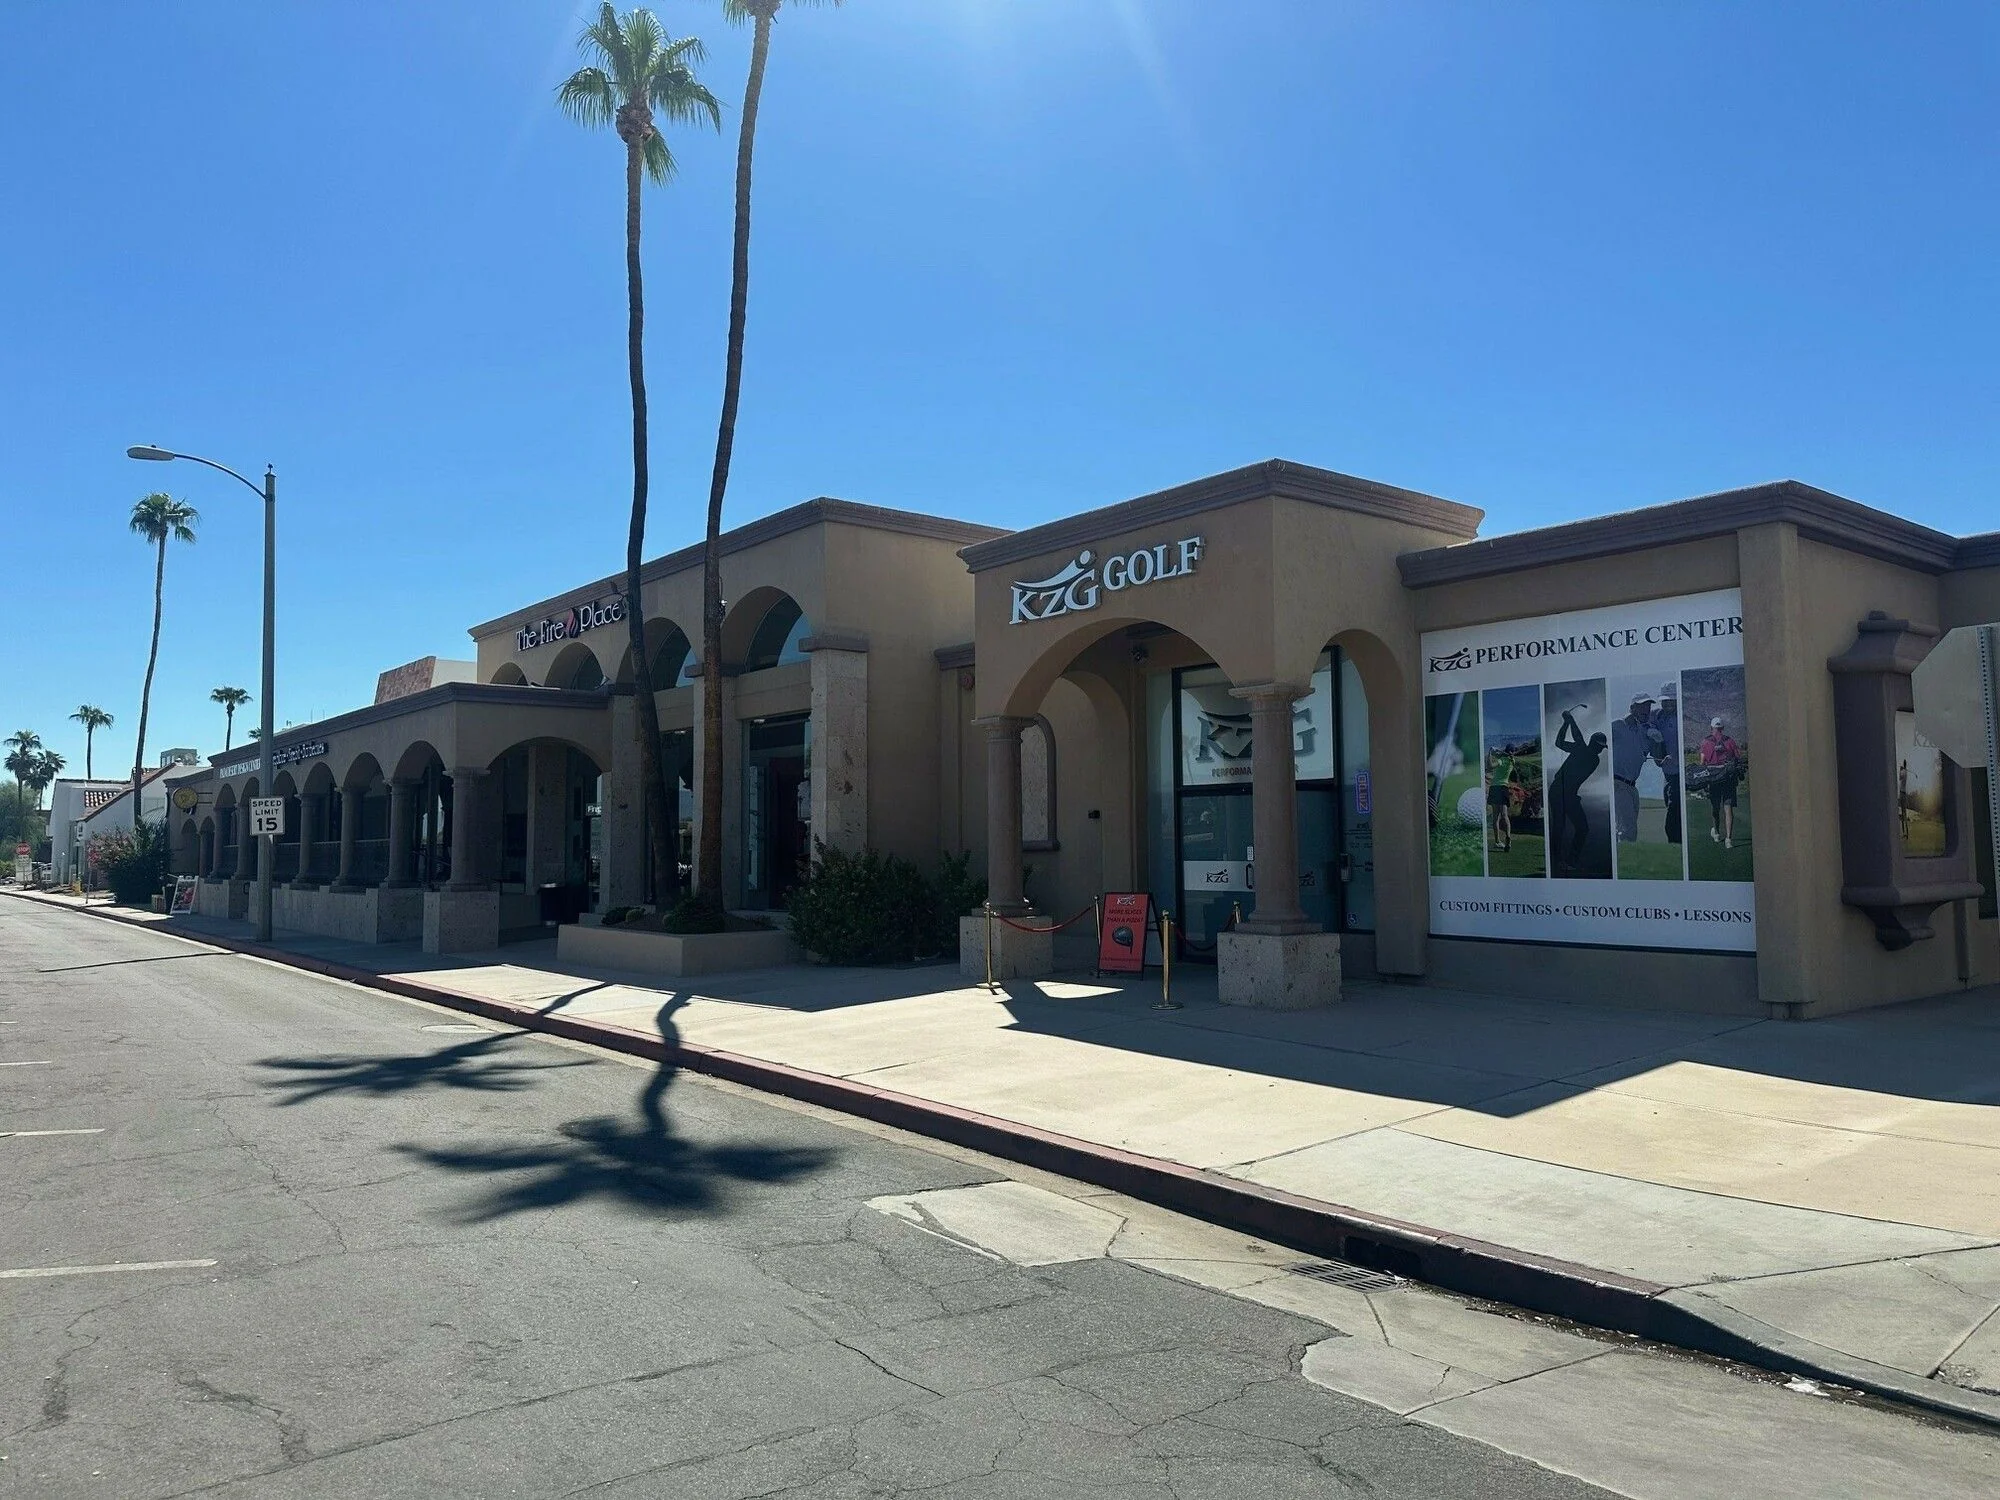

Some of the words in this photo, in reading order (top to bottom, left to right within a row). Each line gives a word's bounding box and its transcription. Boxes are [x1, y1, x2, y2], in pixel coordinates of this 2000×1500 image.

[1009, 568, 1099, 625] KZG
[1103, 537, 1200, 591] GOLF
[516, 626, 536, 651] The
[540, 619, 564, 645] Fire
[580, 602, 622, 632] Place
[1428, 654, 1472, 673] KZG
[1475, 629, 1638, 665] PERFORMANCE
[1644, 616, 1744, 644] CENTER
[255, 808, 279, 816] LIMIT
[257, 817, 278, 832] 15
[1206, 873, 1228, 884] KZG
[1439, 900, 1490, 913] CUSTOM
[1493, 902, 1552, 916] FITTINGS
[1562, 905, 1621, 919] CUSTOM
[1624, 907, 1671, 920] CLUBS
[1683, 909, 1752, 924] LESSONS
